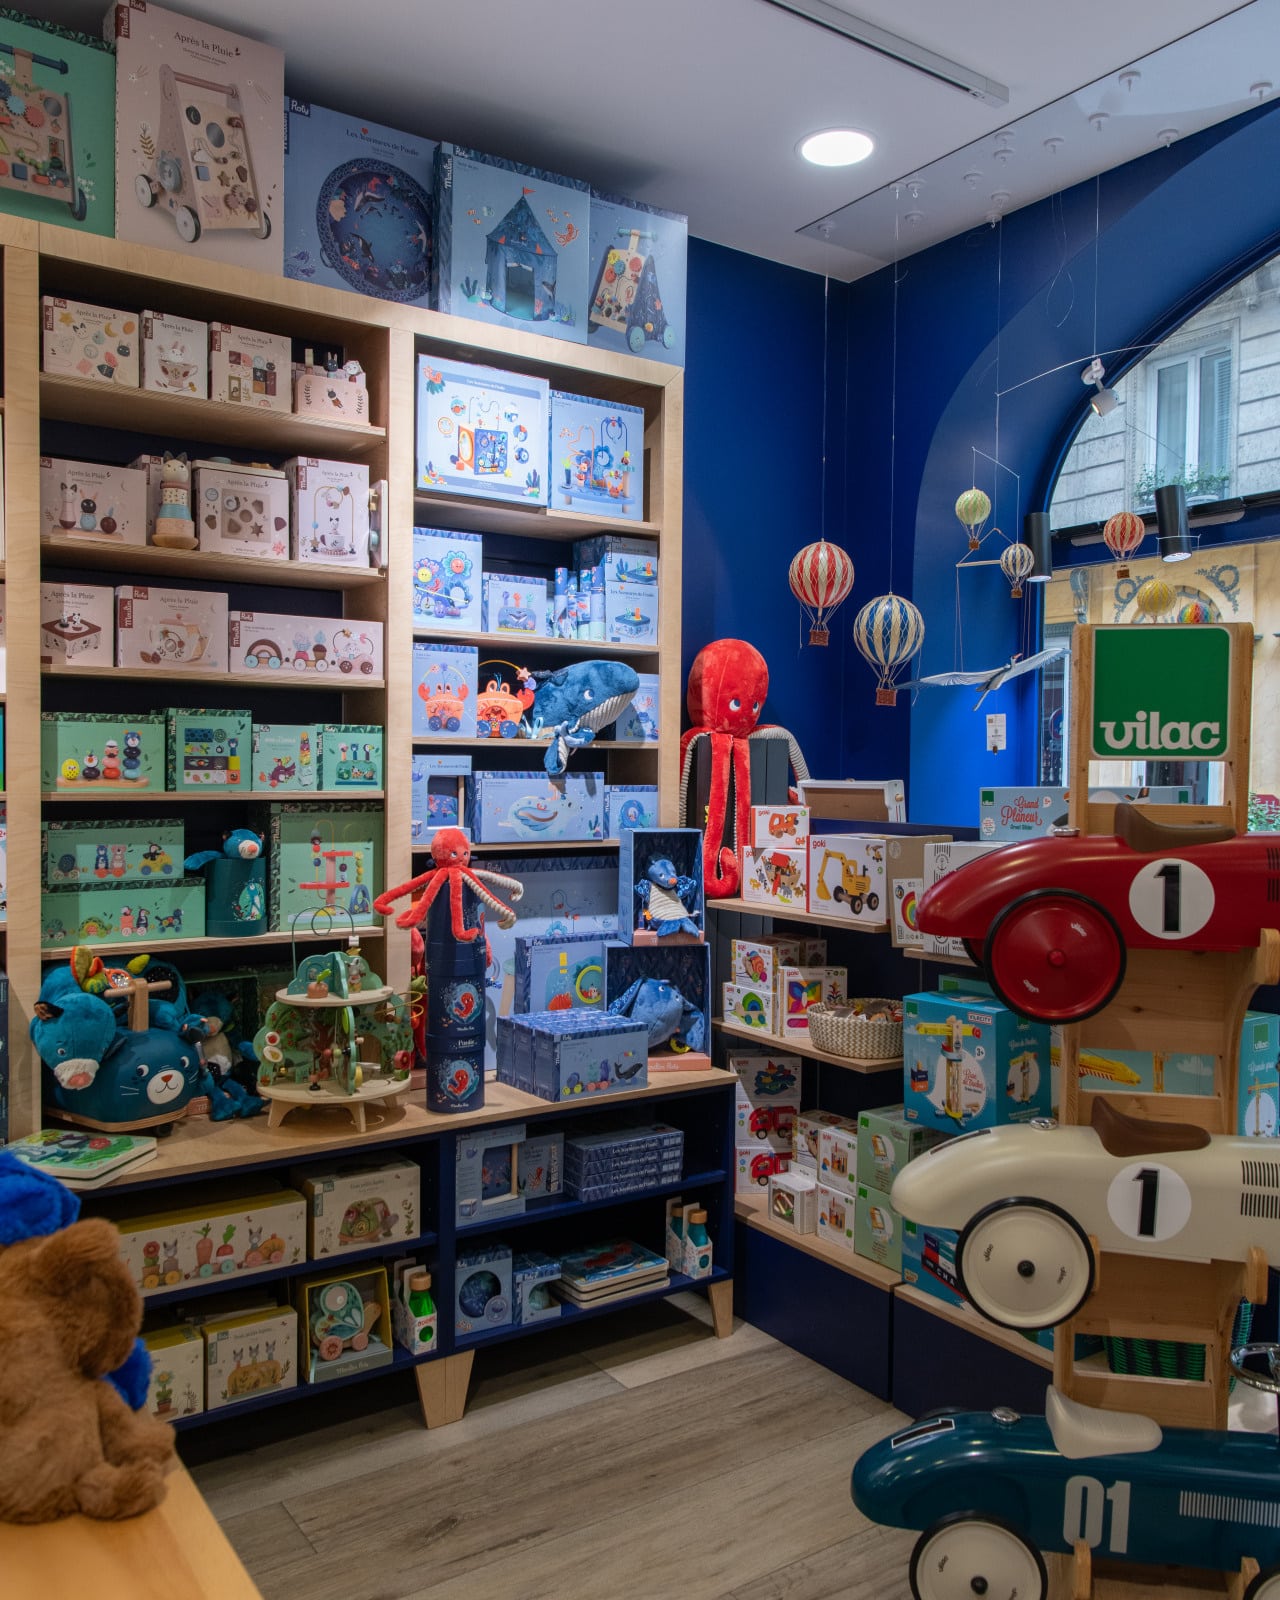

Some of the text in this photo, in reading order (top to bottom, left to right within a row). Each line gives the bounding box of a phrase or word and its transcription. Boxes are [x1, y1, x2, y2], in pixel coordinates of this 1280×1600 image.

[120, 8, 129, 35] Moulin
[174, 32, 200, 48] Après
[202, 40, 209, 50] la
[212, 44, 234, 58] Pluie
[290, 100, 309, 116] Roty
[444, 158, 452, 189] Moulin
[76, 309, 92, 320] Après
[68, 470, 84, 478] Après
[52, 590, 70, 600] Après
[78, 592, 95, 600] Pluie
[160, 596, 176, 604] Après
[1100, 710, 1220, 750] vilac
[1014, 796, 1040, 812] Grand
[1001, 805, 1042, 826] Planeur
[812, 840, 826, 848] goki
[487, 862, 502, 872] Roty
[1154, 863, 1182, 933] 1
[976, 1048, 984, 1057] 3+
[1254, 1041, 1268, 1050] vilac
[1132, 1167, 1160, 1238] 1
[336, 1365, 358, 1375] Moulin
[1063, 1475, 1131, 1554] 01
